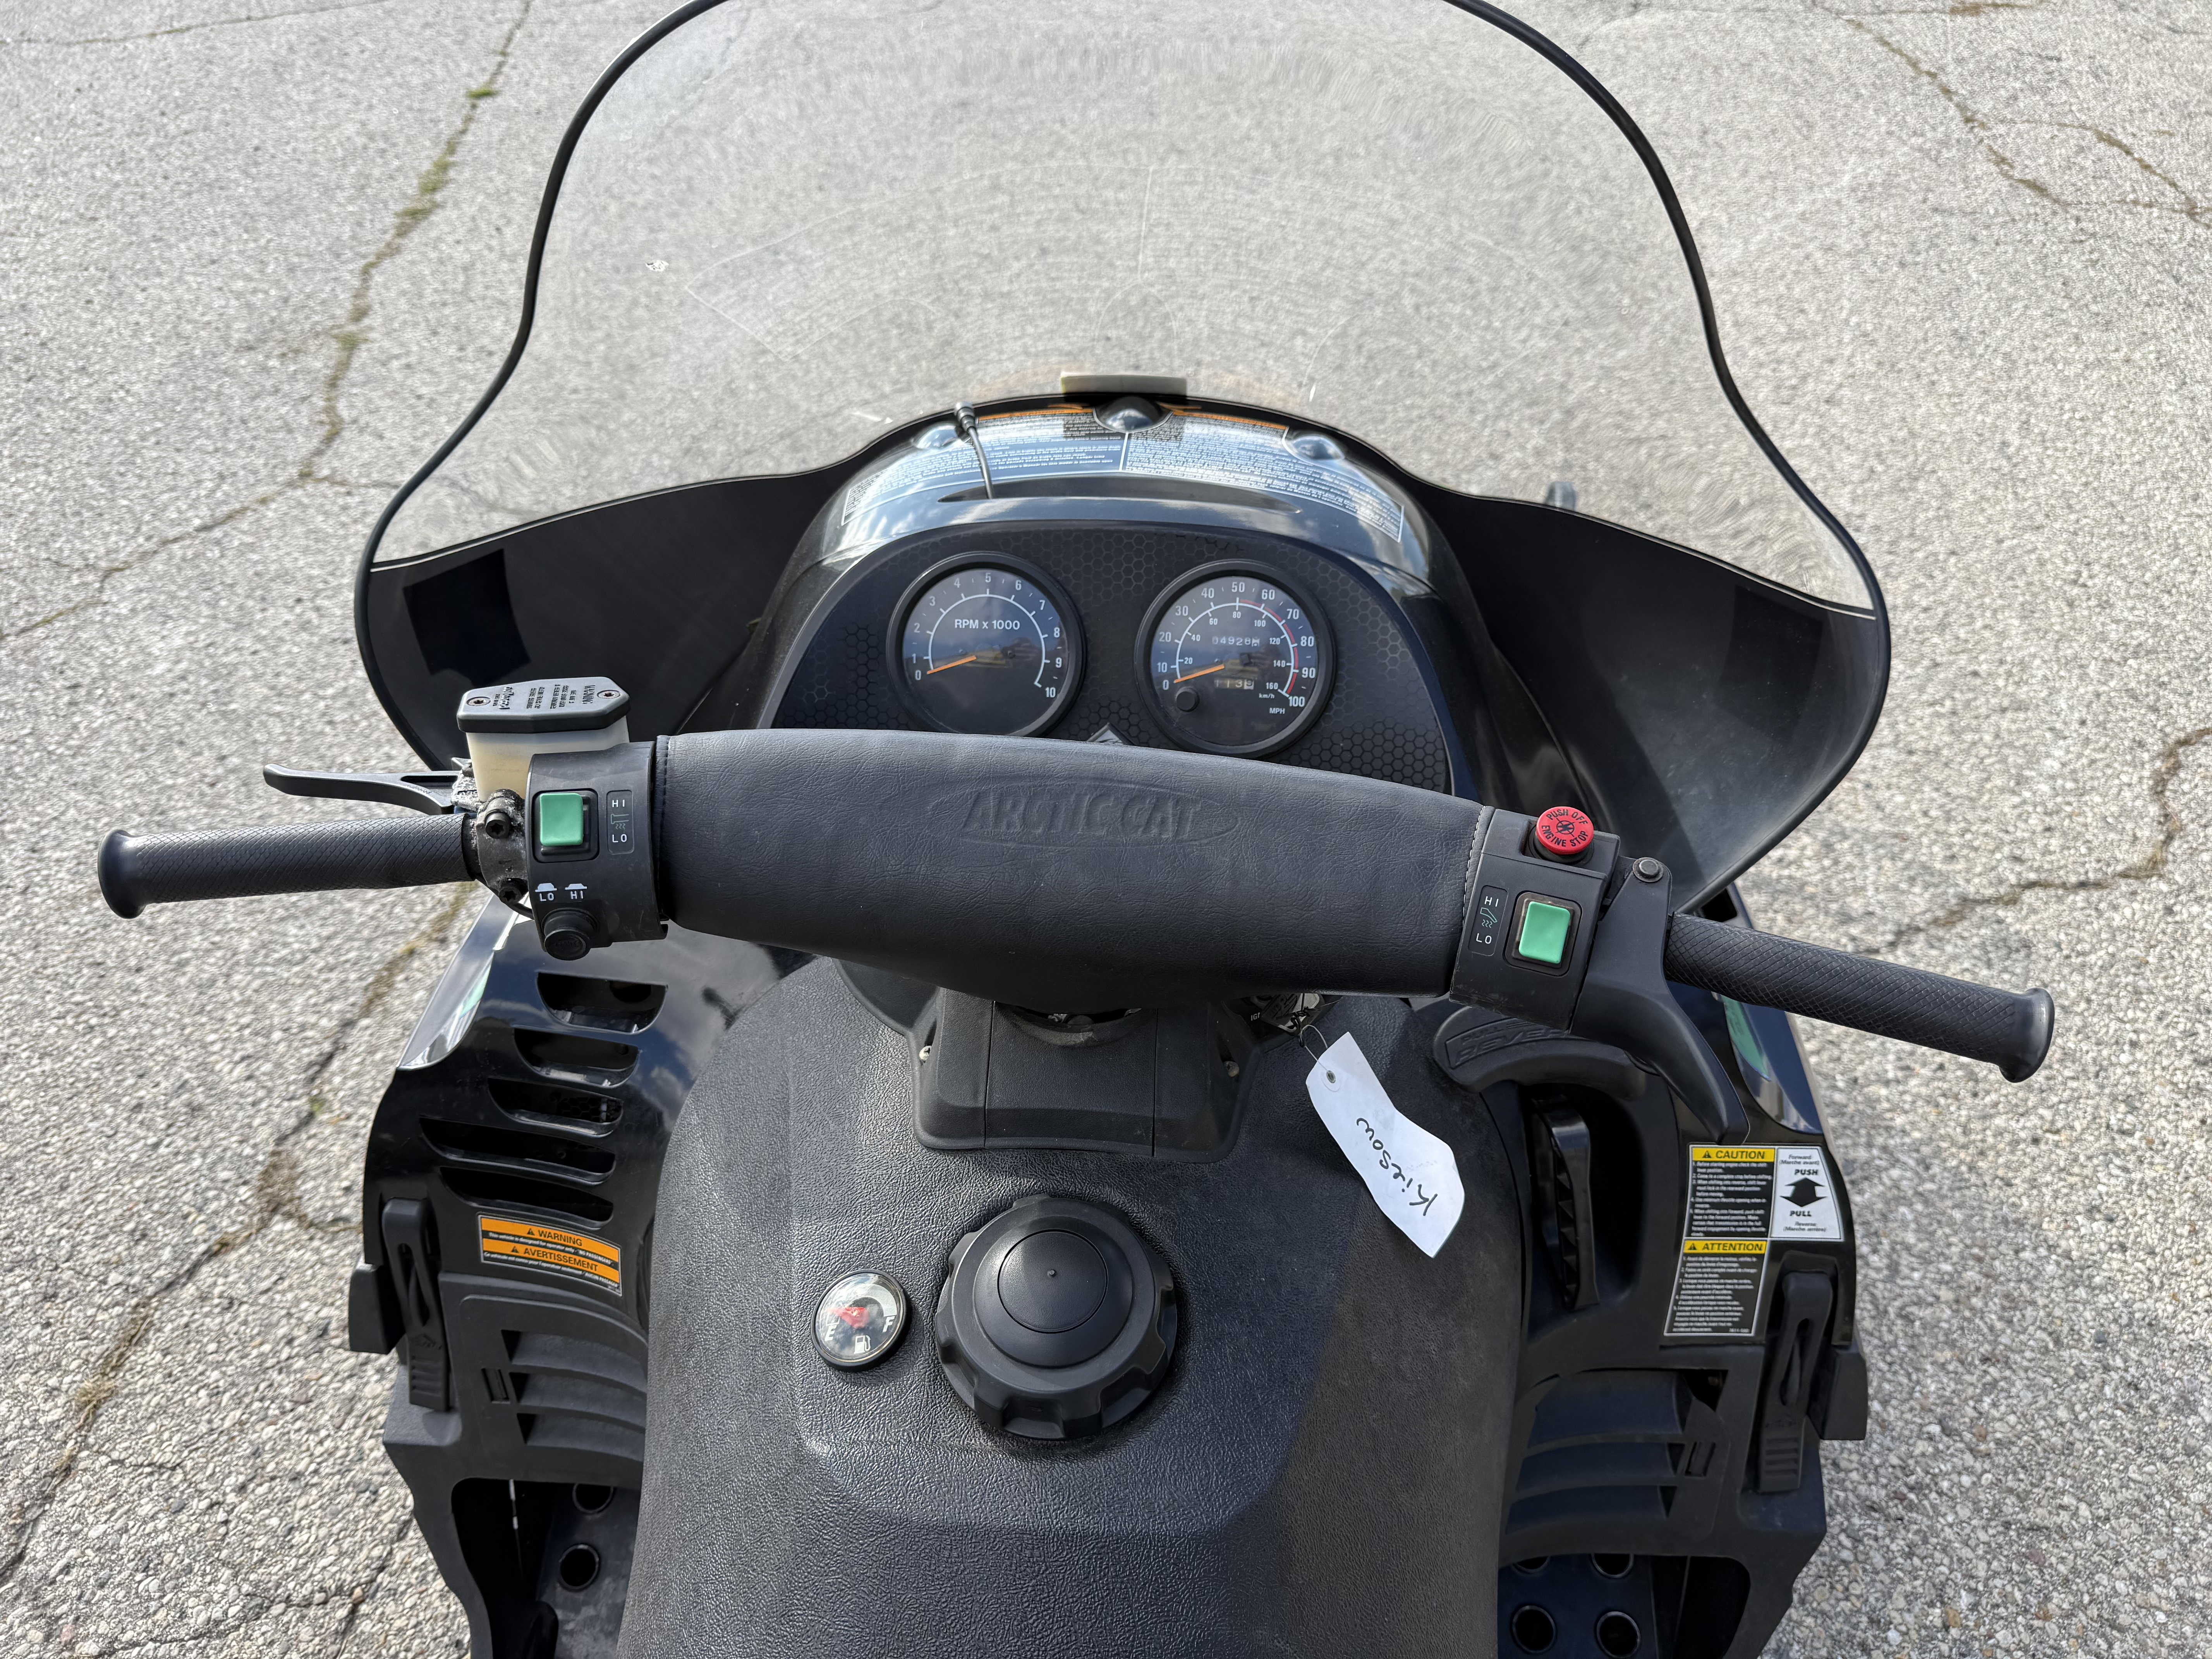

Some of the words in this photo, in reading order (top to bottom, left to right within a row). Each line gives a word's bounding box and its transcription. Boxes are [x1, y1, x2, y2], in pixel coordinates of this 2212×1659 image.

[954, 578, 961, 588] 4
[985, 573, 991, 583] 5
[1015, 580, 1022, 591] 6
[1231, 582, 1245, 592] 50
[1201, 588, 1214, 599] 40
[1262, 589, 1275, 600] 60
[929, 596, 936, 606] 3
[1039, 600, 1046, 610] 7
[1175, 605, 1188, 616] 30
[1287, 608, 1299, 620] 70
[914, 623, 921, 633] 2
[955, 619, 979, 629] RPM
[992, 620, 1020, 630] 1000
[1053, 627, 1060, 638] 8
[1159, 632, 1171, 642] 20
[1300, 636, 1314, 647] 80
[912, 653, 916, 663] 1
[1055, 658, 1062, 668] 9
[1157, 662, 1168, 673] 10
[1302, 667, 1316, 678] 90
[914, 670, 922, 680] 0
[1163, 680, 1169, 690] 0
[1045, 687, 1056, 698] 10
[1288, 696, 1305, 707] 100
[611, 799, 626, 808] HI
[1546, 809, 1569, 821] PUSH
[1571, 811, 1588, 825] OFF
[611, 834, 627, 843] LO
[1541, 825, 1566, 847] ENGINE
[1570, 830, 1589, 847] STOP
[539, 892, 555, 902] LO
[570, 891, 584, 900] HI
[1484, 895, 1499, 907] HI
[1475, 933, 1492, 945] LO
[1715, 1150, 1765, 1160] CAUTION
[538, 1230, 582, 1247] WARNING
[1702, 1243, 1763, 1252] ATTENTION
[523, 1247, 598, 1272] AVERTISSEMENT
[882, 1316, 895, 1333] F
[824, 1325, 838, 1341] E
